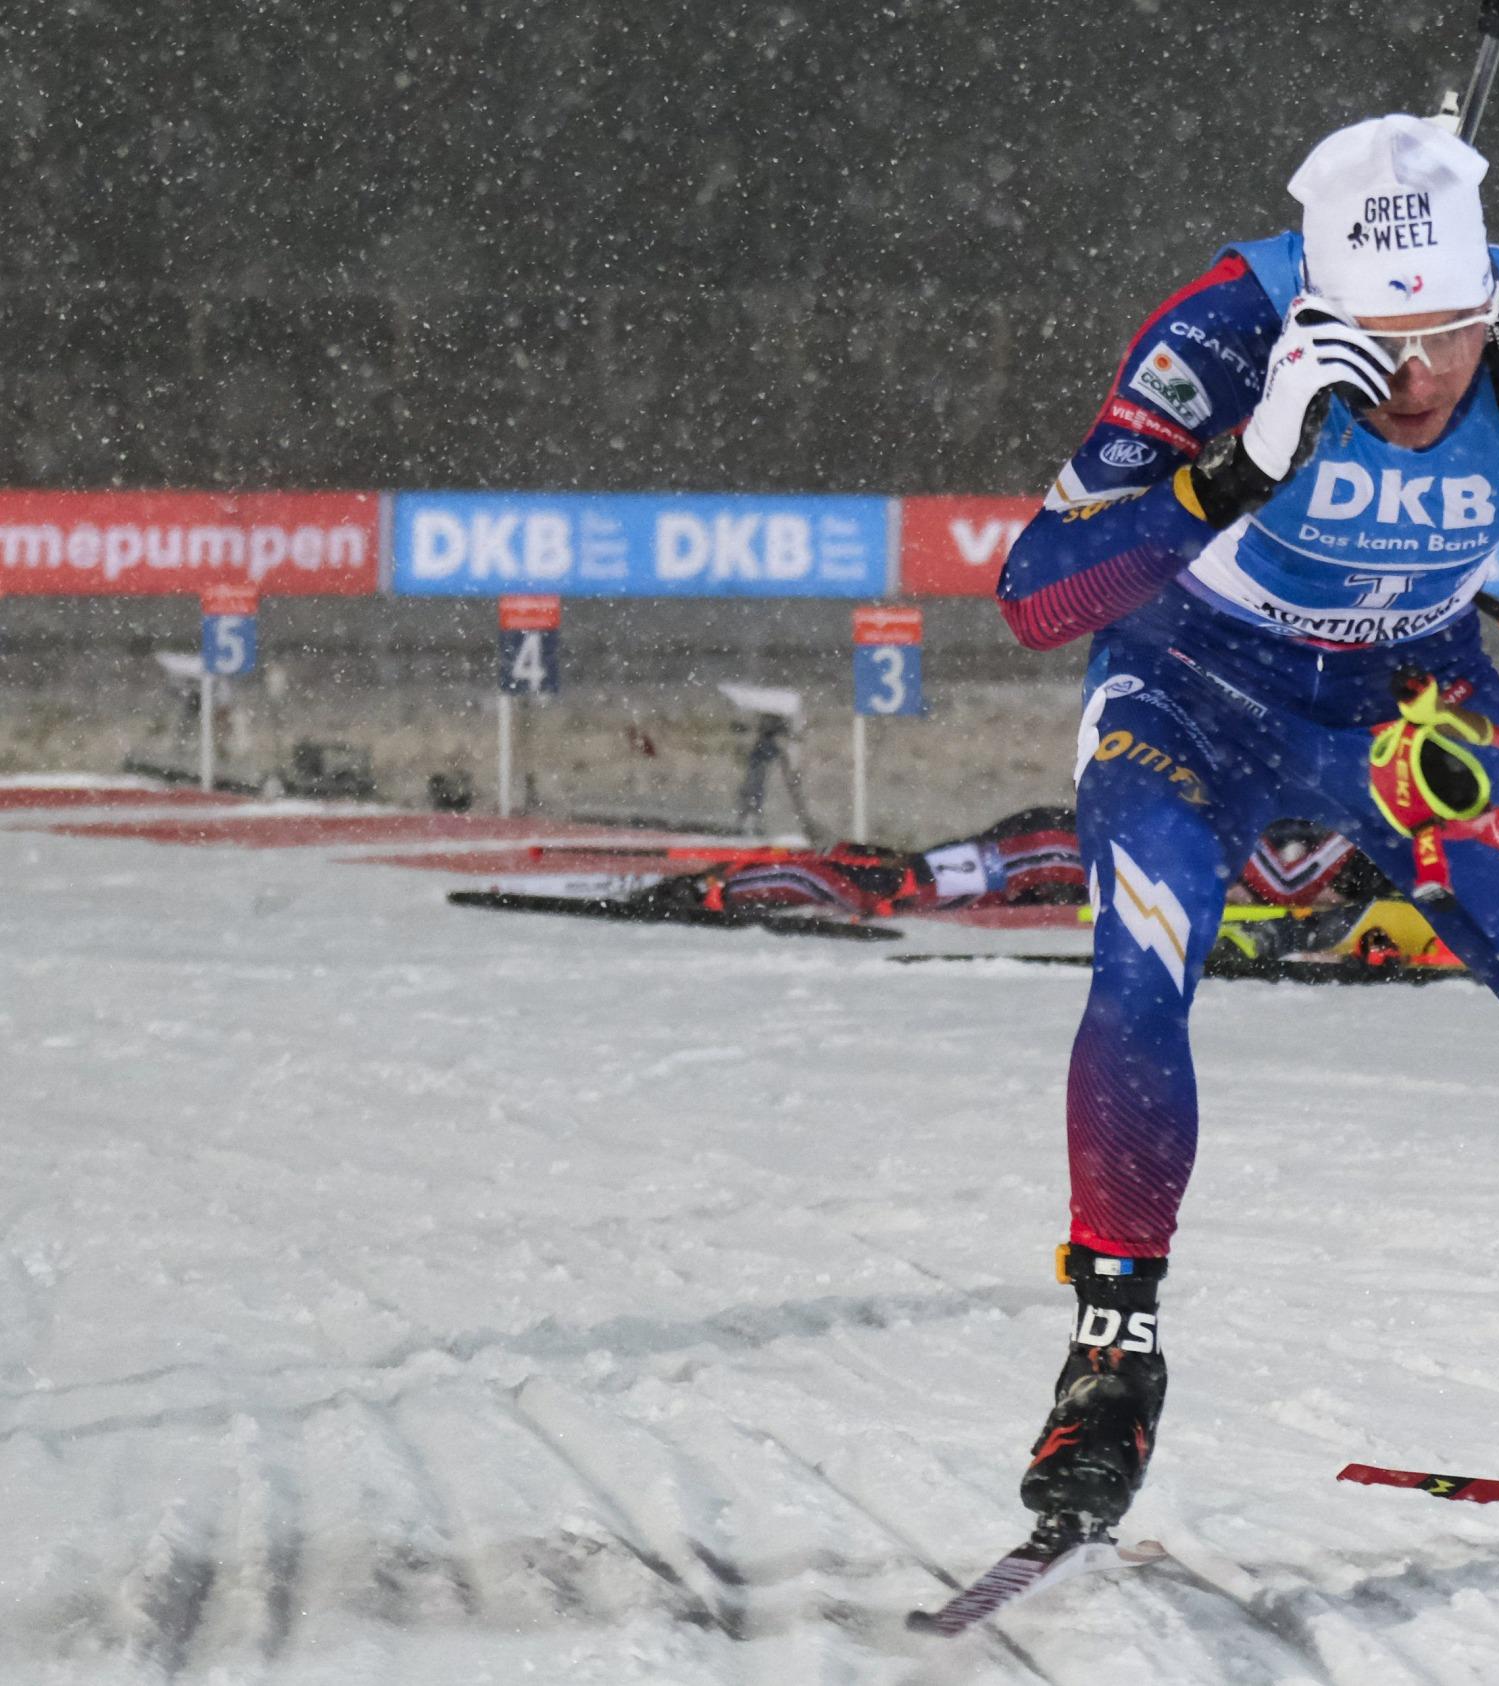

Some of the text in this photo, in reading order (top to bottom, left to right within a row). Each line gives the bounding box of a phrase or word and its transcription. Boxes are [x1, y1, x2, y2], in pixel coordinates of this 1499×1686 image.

[1364, 192, 1431, 223] GREEN
[1374, 221, 1438, 251] WEEZ
[1170, 321, 1248, 373] CRAFT
[1306, 460, 1496, 530] DKB
[0, 524, 366, 582] mepumpen
[411, 509, 574, 580] DKB
[656, 511, 813, 581] DKB
[1299, 524, 1489, 552] Das kann Bank
[215, 616, 246, 674] 5
[511, 630, 547, 692] 4
[871, 648, 907, 713] 3
[1395, 736, 1412, 808] LEKI
